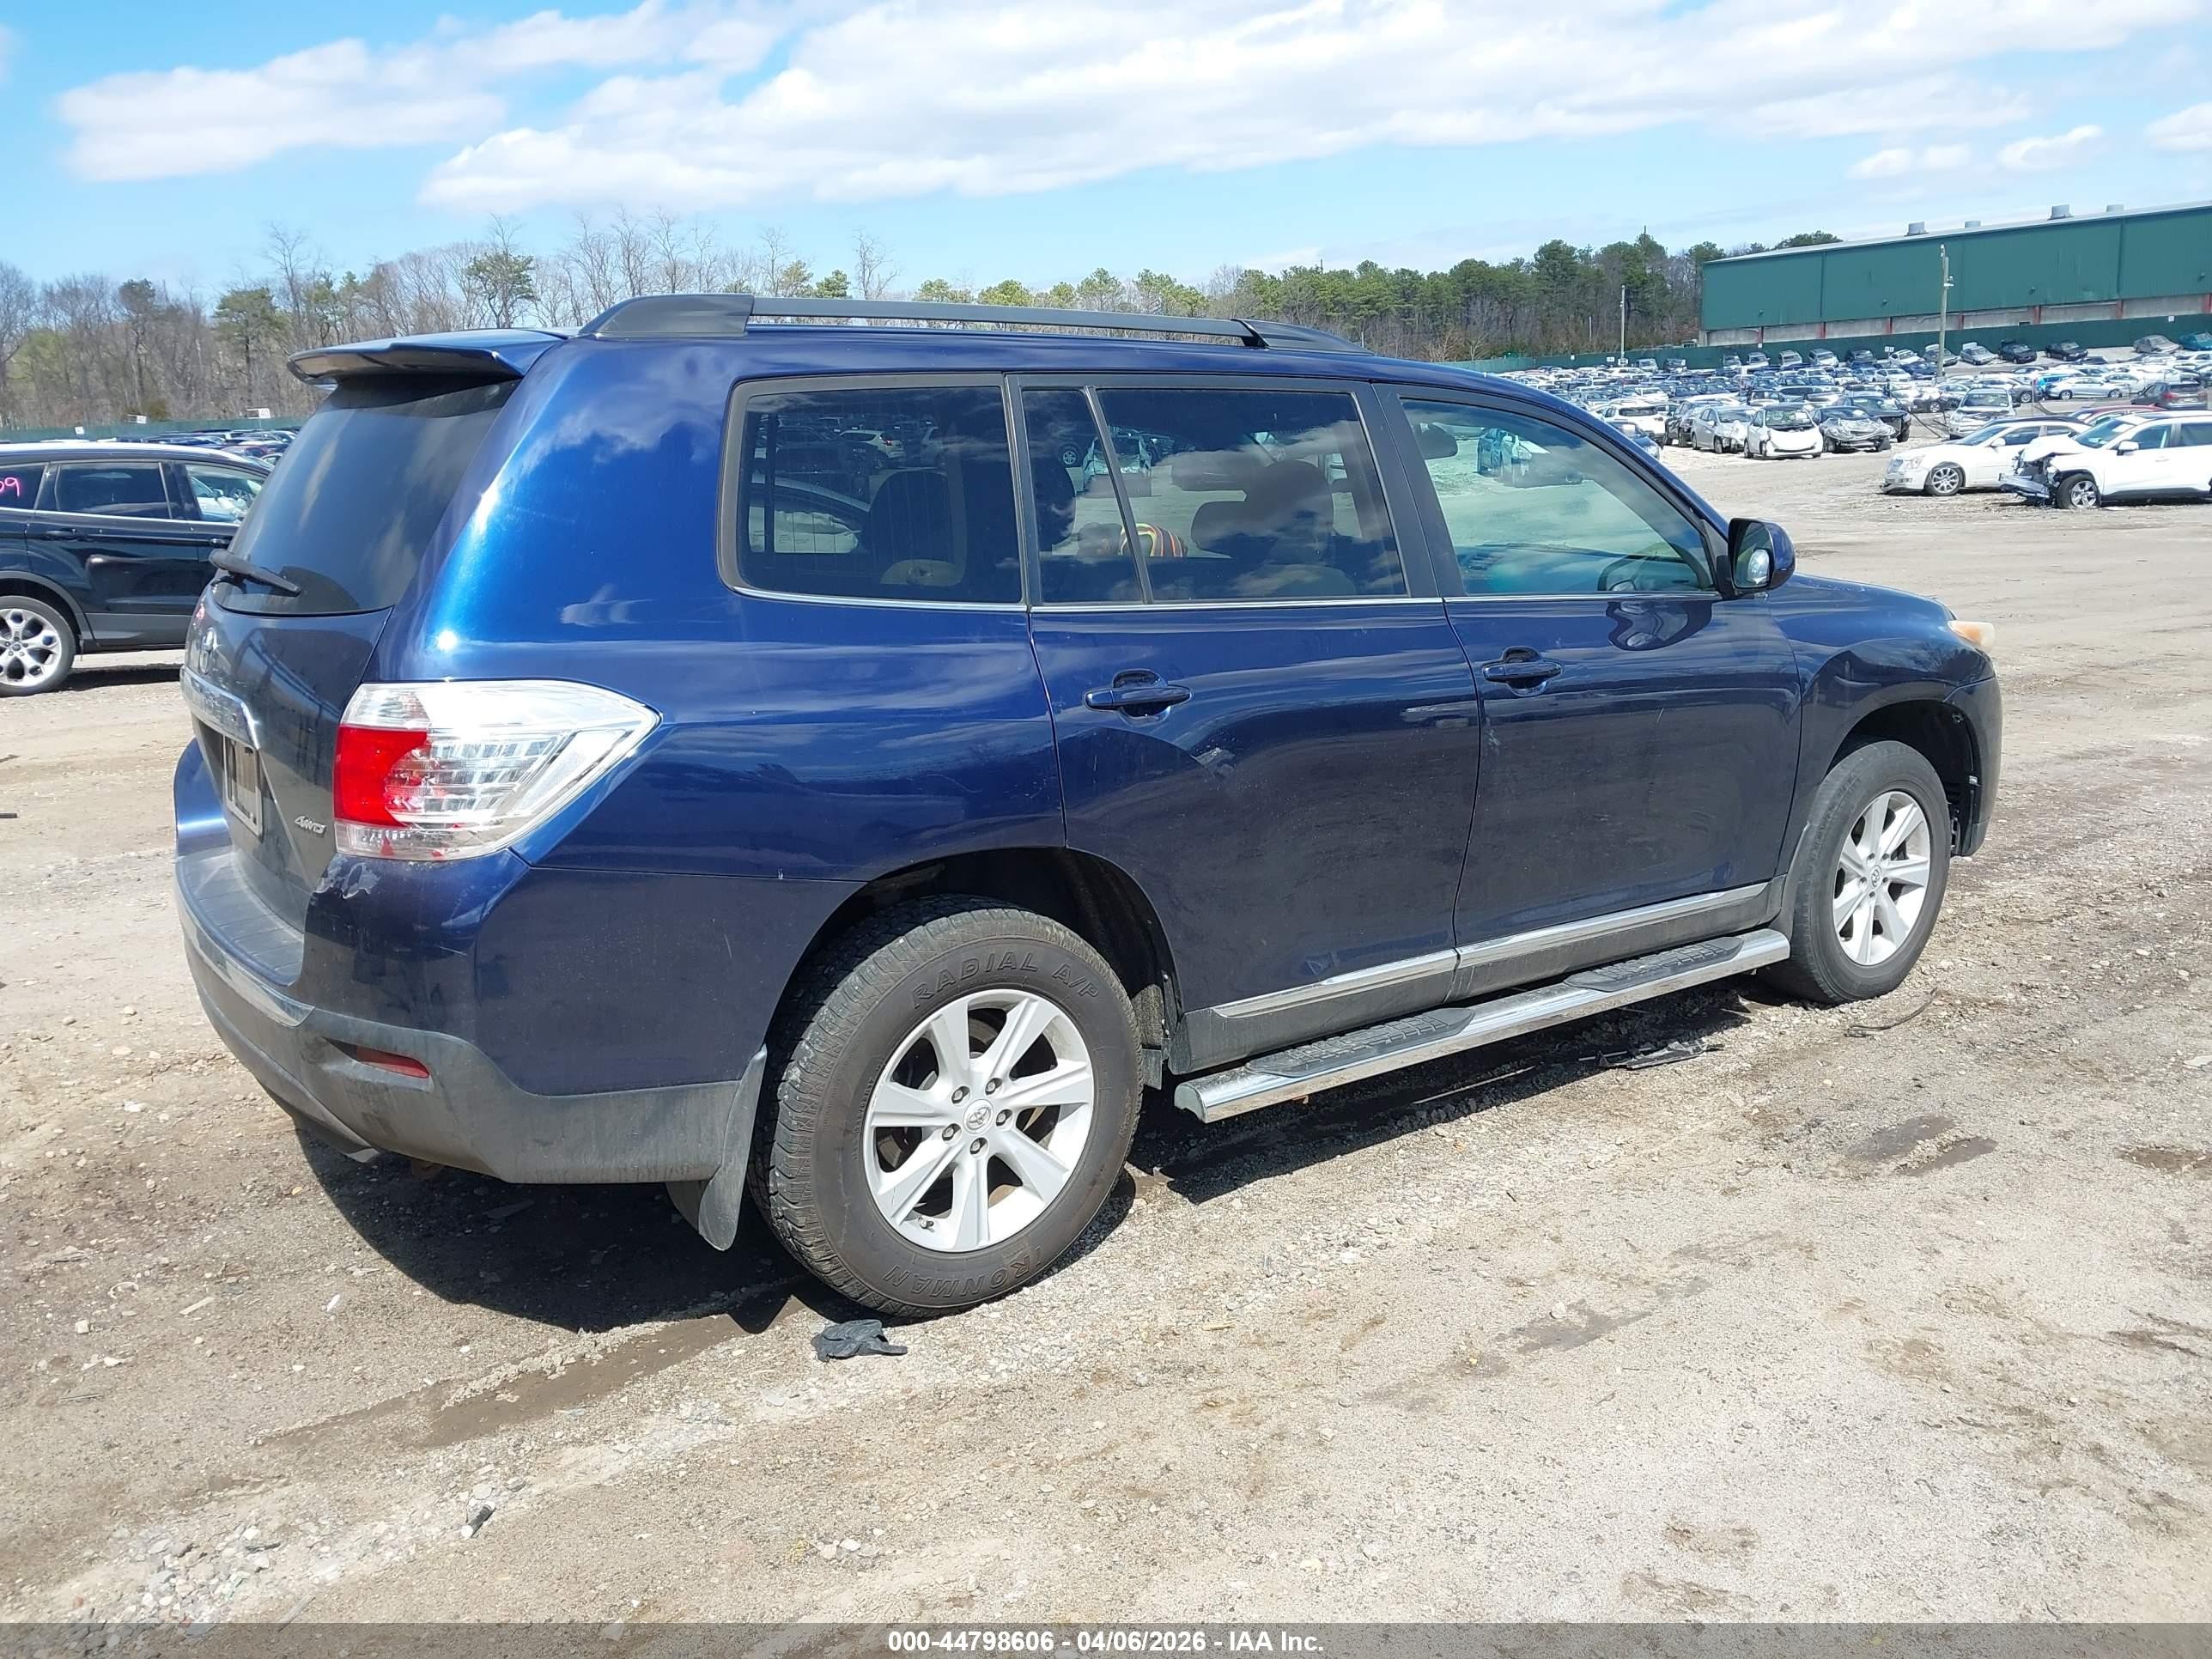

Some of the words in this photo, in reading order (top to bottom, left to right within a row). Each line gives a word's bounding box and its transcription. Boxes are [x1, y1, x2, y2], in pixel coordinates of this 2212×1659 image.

[295, 815, 326, 834] 4WD
[910, 951, 1038, 1009] RADIAL
[1052, 963, 1099, 998] A/P
[883, 1246, 1042, 1298] IRONMAN
